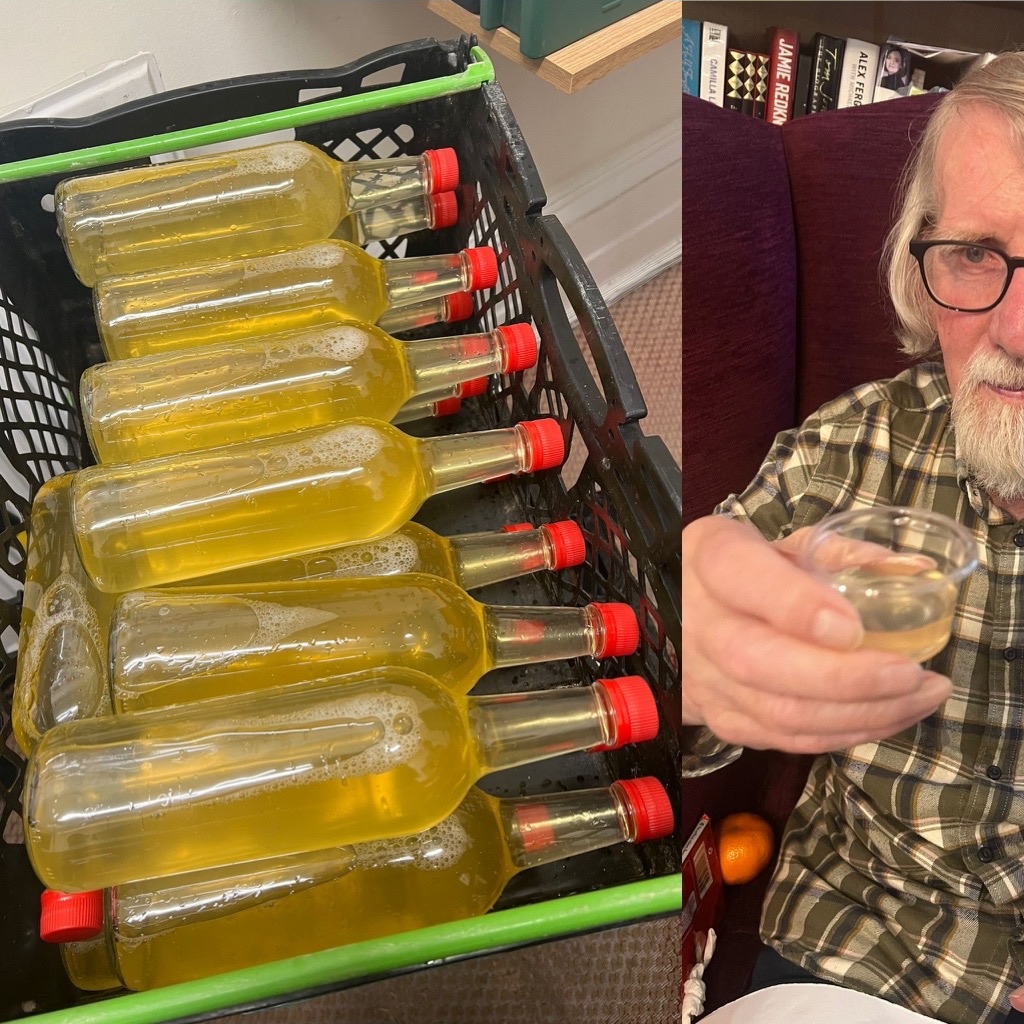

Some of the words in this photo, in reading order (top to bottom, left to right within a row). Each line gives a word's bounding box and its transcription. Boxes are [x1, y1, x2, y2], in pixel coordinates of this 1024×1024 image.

[709, 59, 718, 94] CAMILLA
[776, 38, 794, 81] JAMIE
[821, 48, 838, 81] Tom
[857, 51, 869, 79] ALEX
[772, 83, 790, 126] REDKN
[853, 81, 865, 106] FERG
